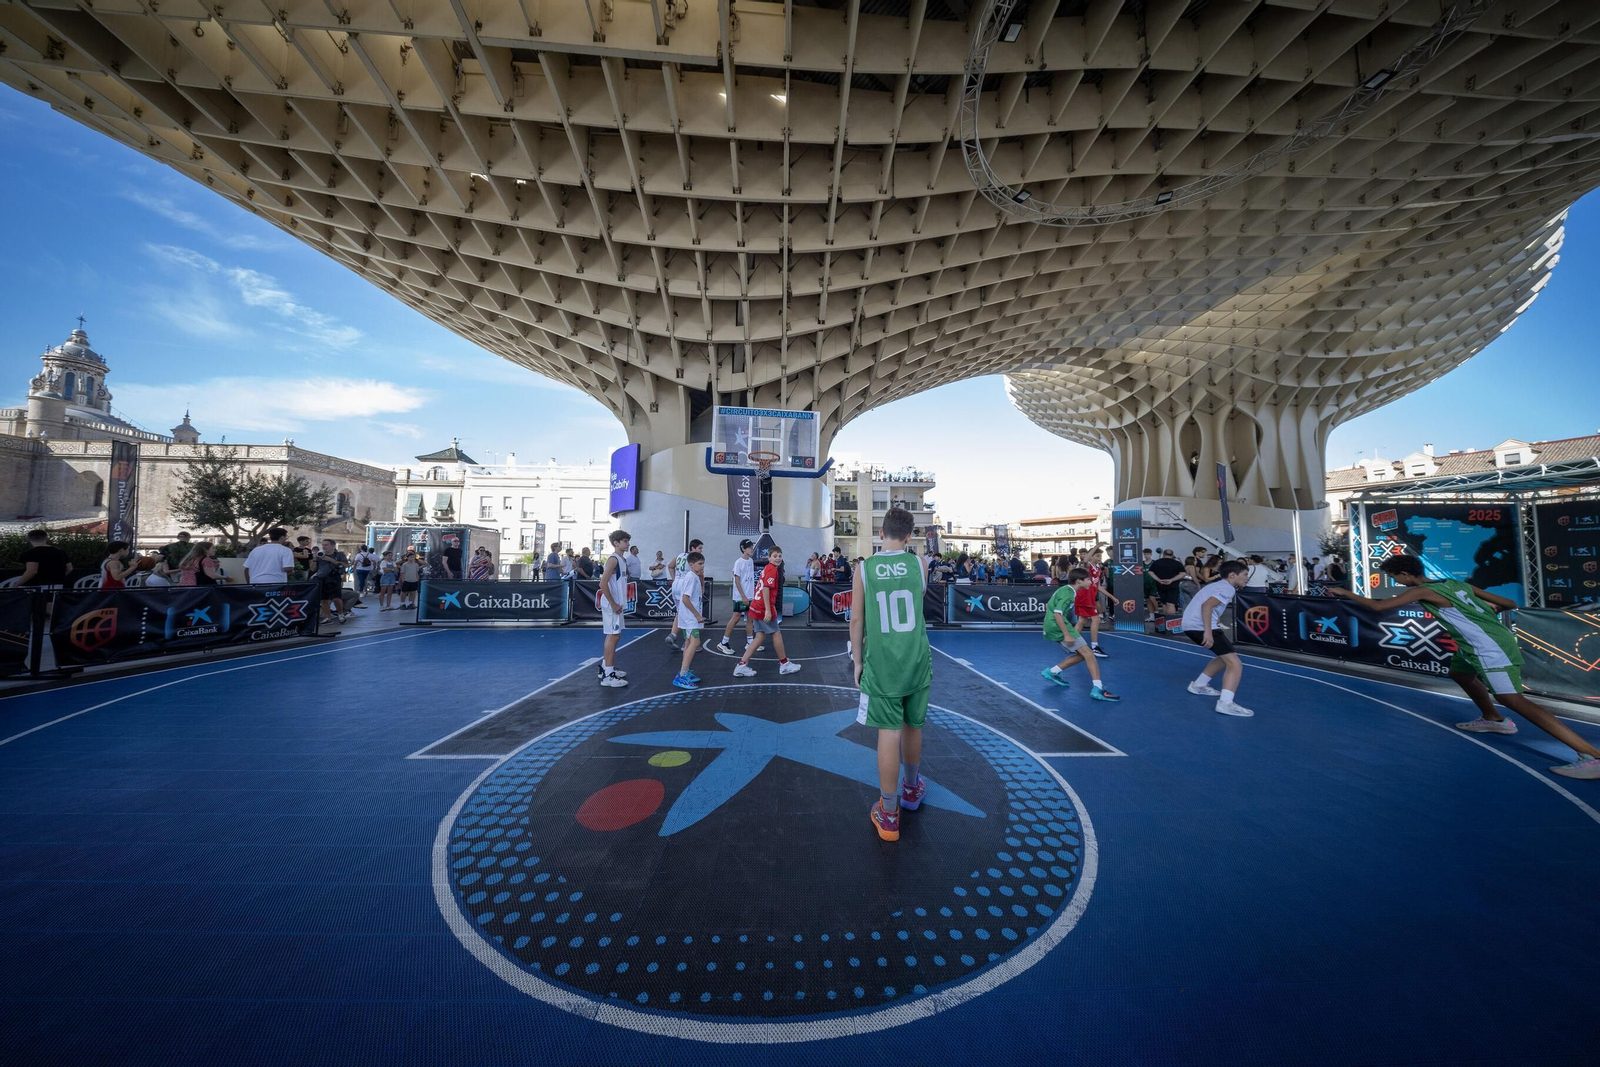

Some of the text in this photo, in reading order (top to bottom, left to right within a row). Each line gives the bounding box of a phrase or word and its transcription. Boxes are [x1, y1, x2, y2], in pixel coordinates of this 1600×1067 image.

[720, 408, 812, 419] #CIRCUITO3X3CAIXABANK
[1468, 509, 1501, 521] 2025
[875, 562, 908, 577] CNS
[464, 592, 550, 609] CaixaBank
[875, 589, 916, 633] 10
[176, 626, 218, 637] CaixaBank
[251, 626, 299, 641] CaixaBank
[1309, 632, 1348, 645] CaixaBank
[1387, 654, 1451, 674] CaixaBa
